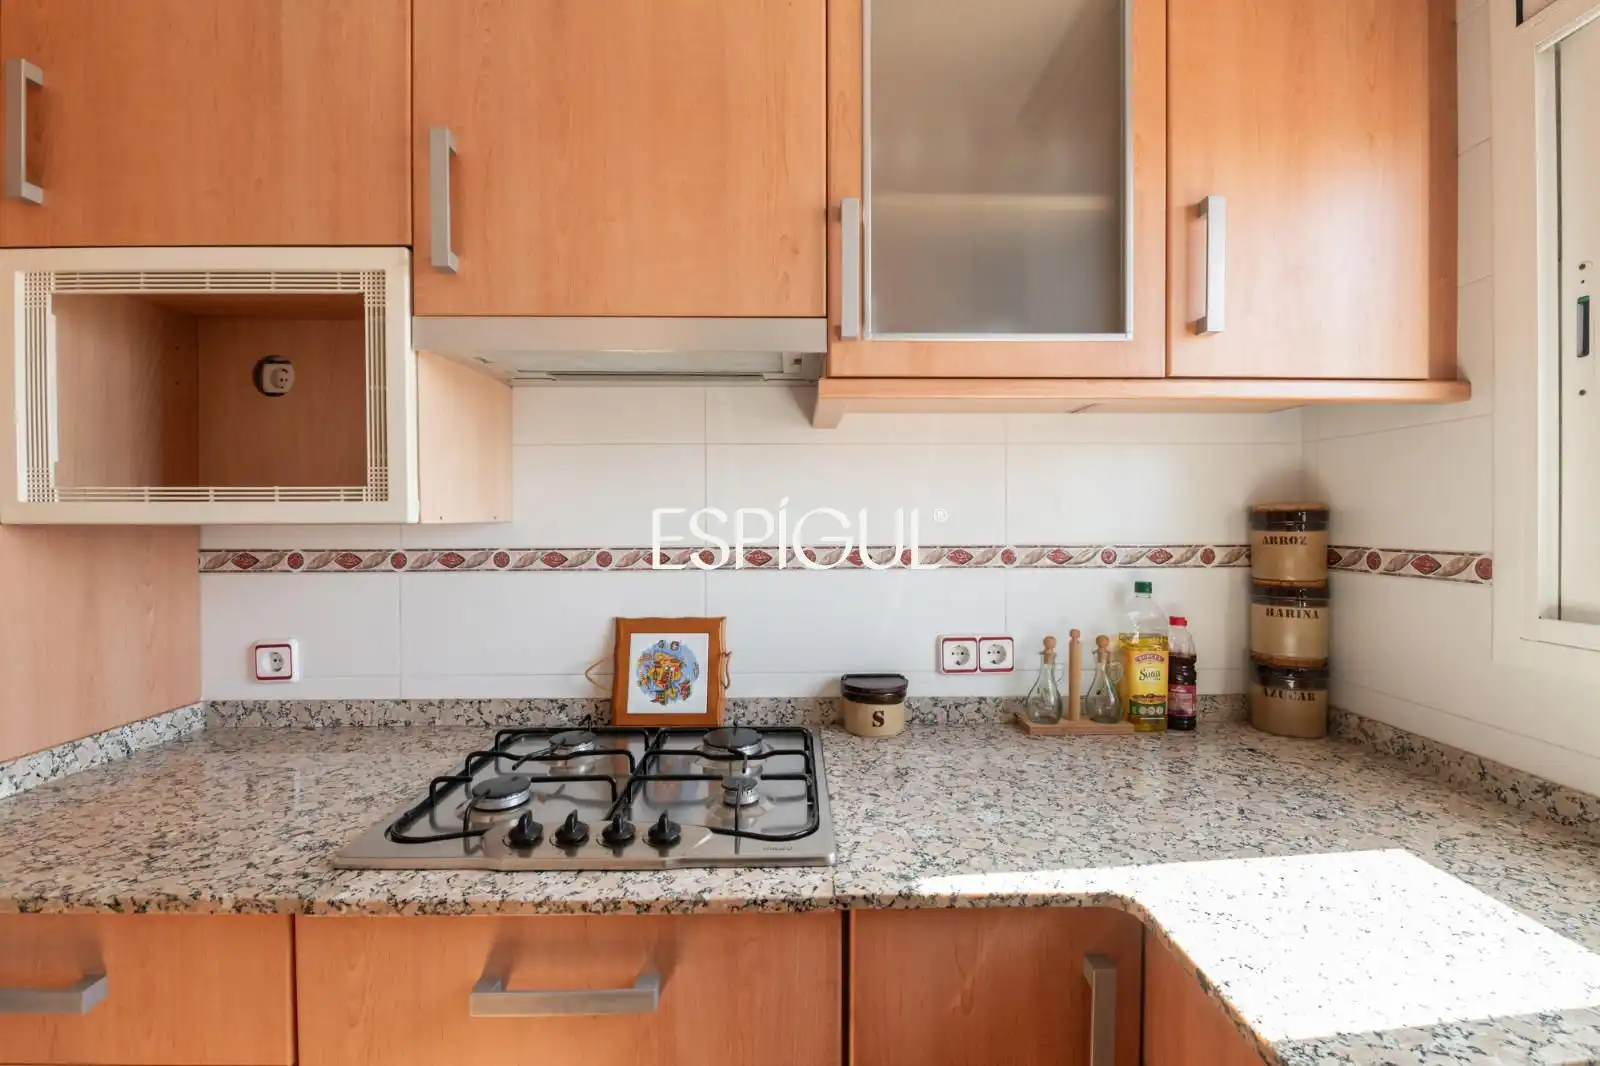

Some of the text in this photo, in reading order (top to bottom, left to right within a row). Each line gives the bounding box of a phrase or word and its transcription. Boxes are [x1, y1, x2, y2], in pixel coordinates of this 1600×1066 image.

[1262, 535, 1308, 546] ARROZ
[1265, 607, 1319, 620] HARINA
[872, 710, 885, 728] S
